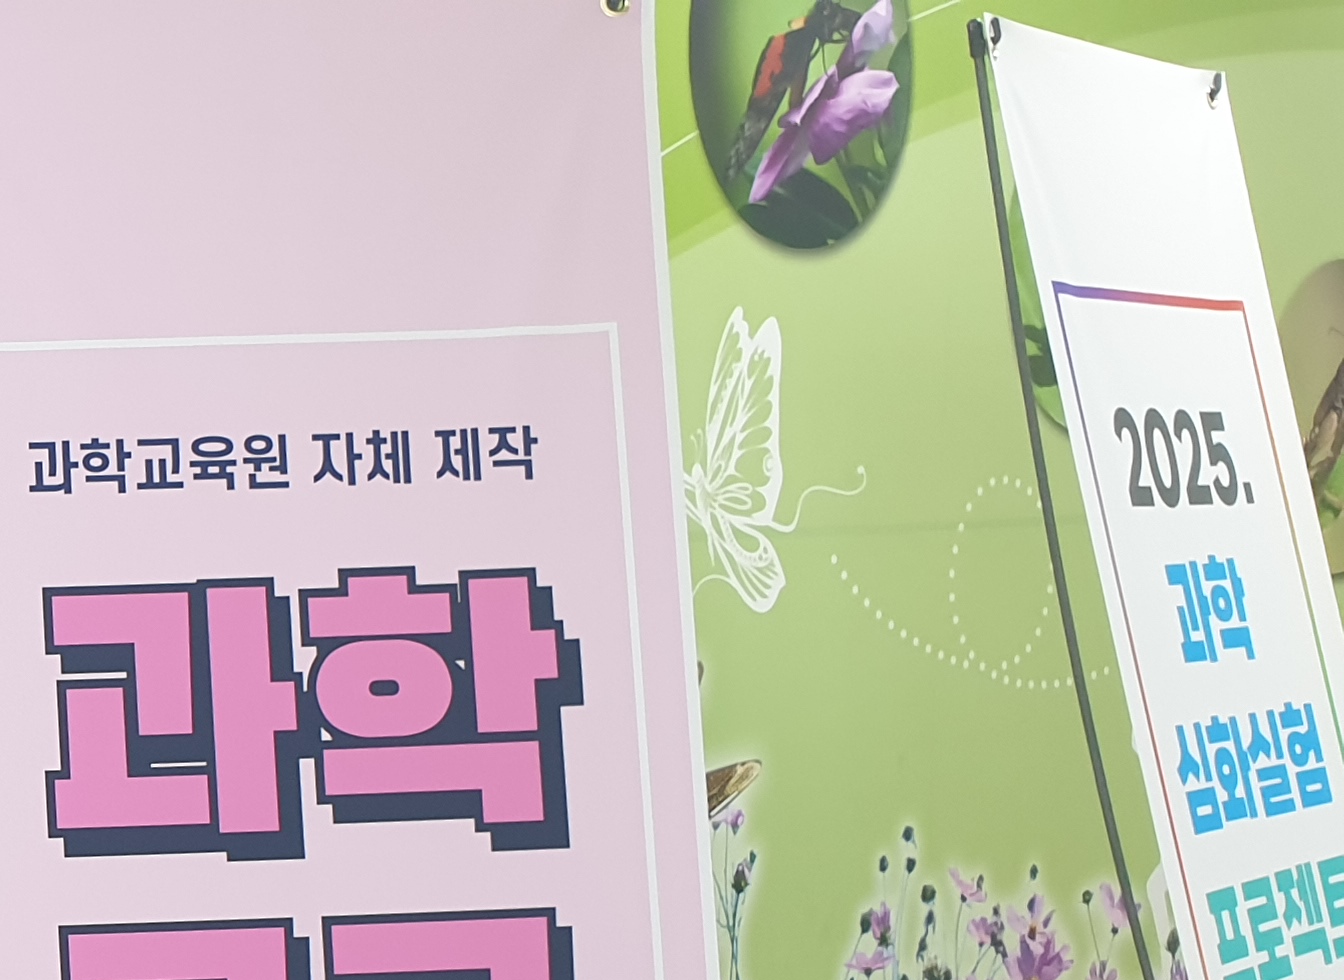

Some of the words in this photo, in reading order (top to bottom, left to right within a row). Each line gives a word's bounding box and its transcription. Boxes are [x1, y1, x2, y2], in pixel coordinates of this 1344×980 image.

[28, 433, 290, 495] 과학교육원
[311, 430, 413, 487] 자체
[434, 425, 539, 483] 제작
[1113, 407, 1255, 508] 2025.
[1165, 554, 1257, 664] 과학
[42, 565, 585, 861] 과학
[1175, 701, 1334, 836] 심화실험
